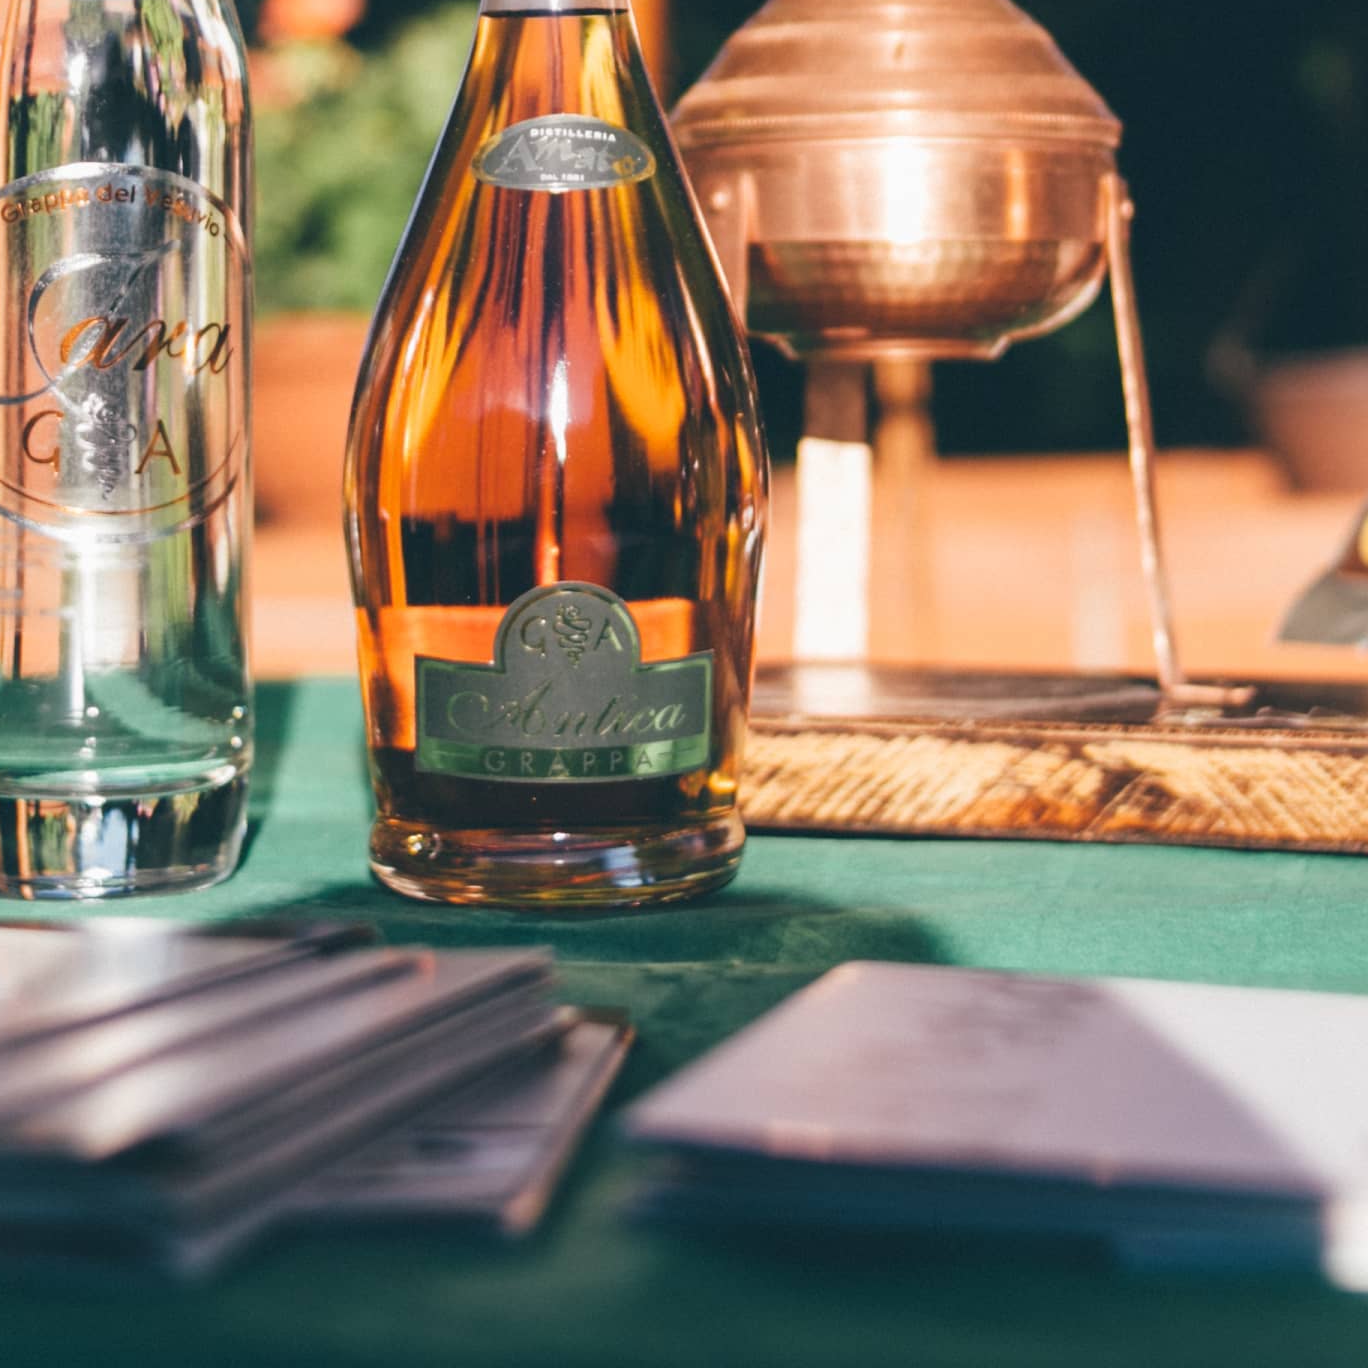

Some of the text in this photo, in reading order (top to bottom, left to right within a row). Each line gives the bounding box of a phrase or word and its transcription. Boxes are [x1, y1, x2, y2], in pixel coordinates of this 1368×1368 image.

[530, 128, 617, 142] DISTILLERIA
[0, 186, 91, 224] Grappa
[95, 183, 136, 204] del
[484, 747, 654, 779] GRAPPA
